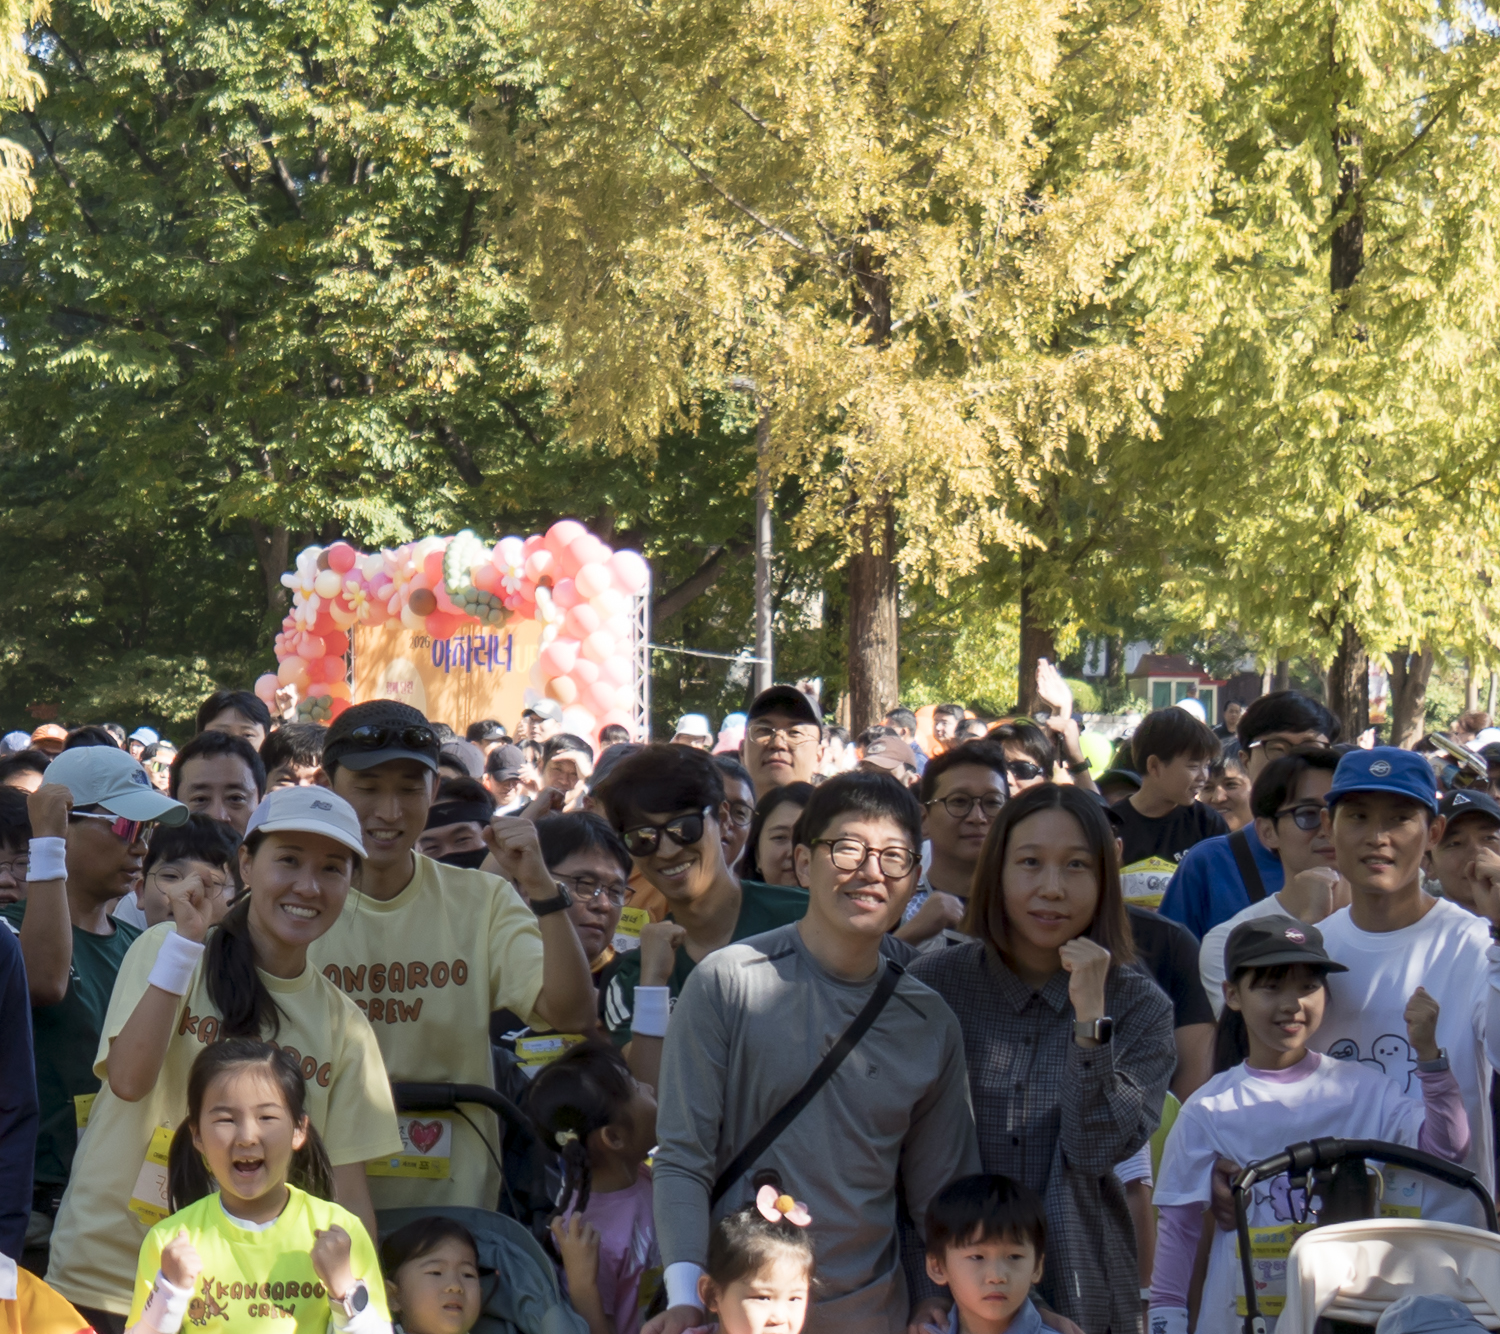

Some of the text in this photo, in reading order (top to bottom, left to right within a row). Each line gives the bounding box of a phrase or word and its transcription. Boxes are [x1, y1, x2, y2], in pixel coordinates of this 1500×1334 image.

[322, 959, 468, 994] ANGAROO
[1253, 1232, 1286, 1244] 2026
[216, 1281, 326, 1301] KANGAROO
[247, 1302, 296, 1319] CREW
